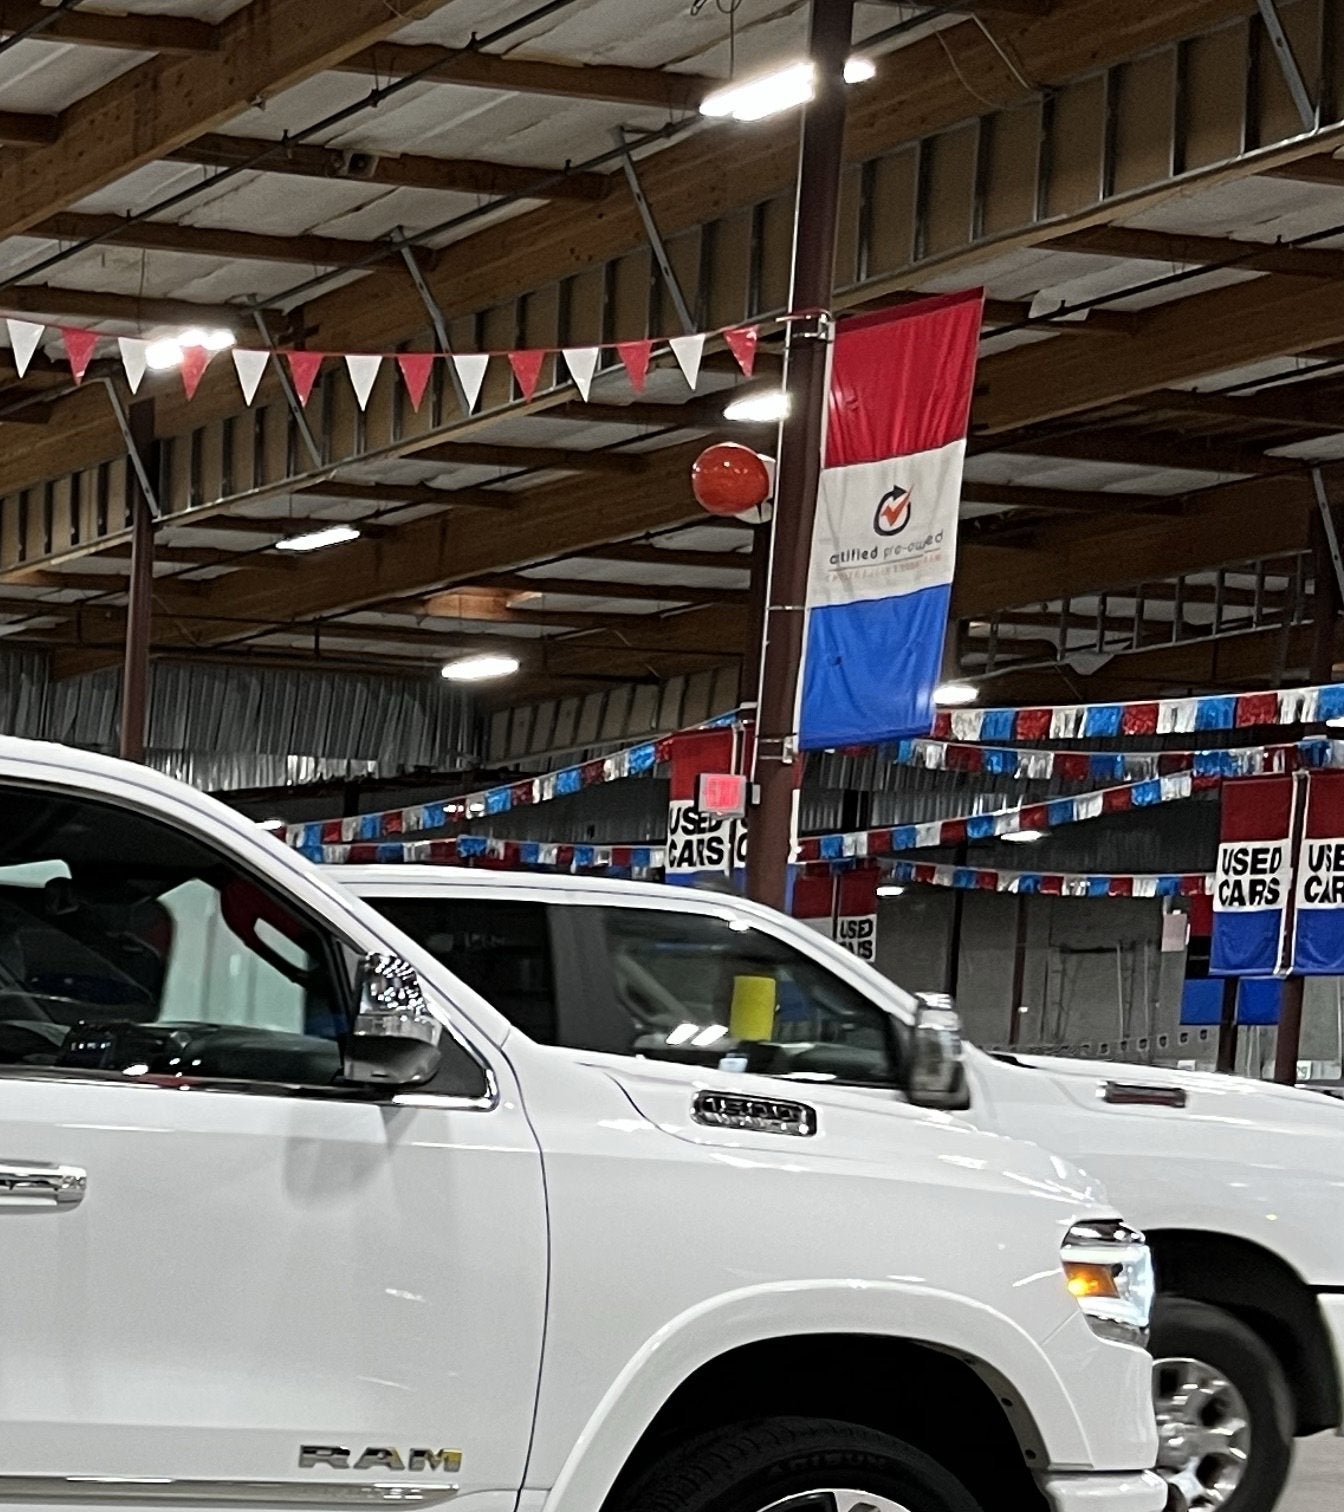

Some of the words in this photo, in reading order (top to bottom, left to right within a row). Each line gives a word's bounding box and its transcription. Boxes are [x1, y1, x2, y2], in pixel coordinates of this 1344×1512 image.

[1222, 846, 1282, 876] USED
[1218, 877, 1281, 906] CARS
[298, 1444, 462, 1472] RAM
